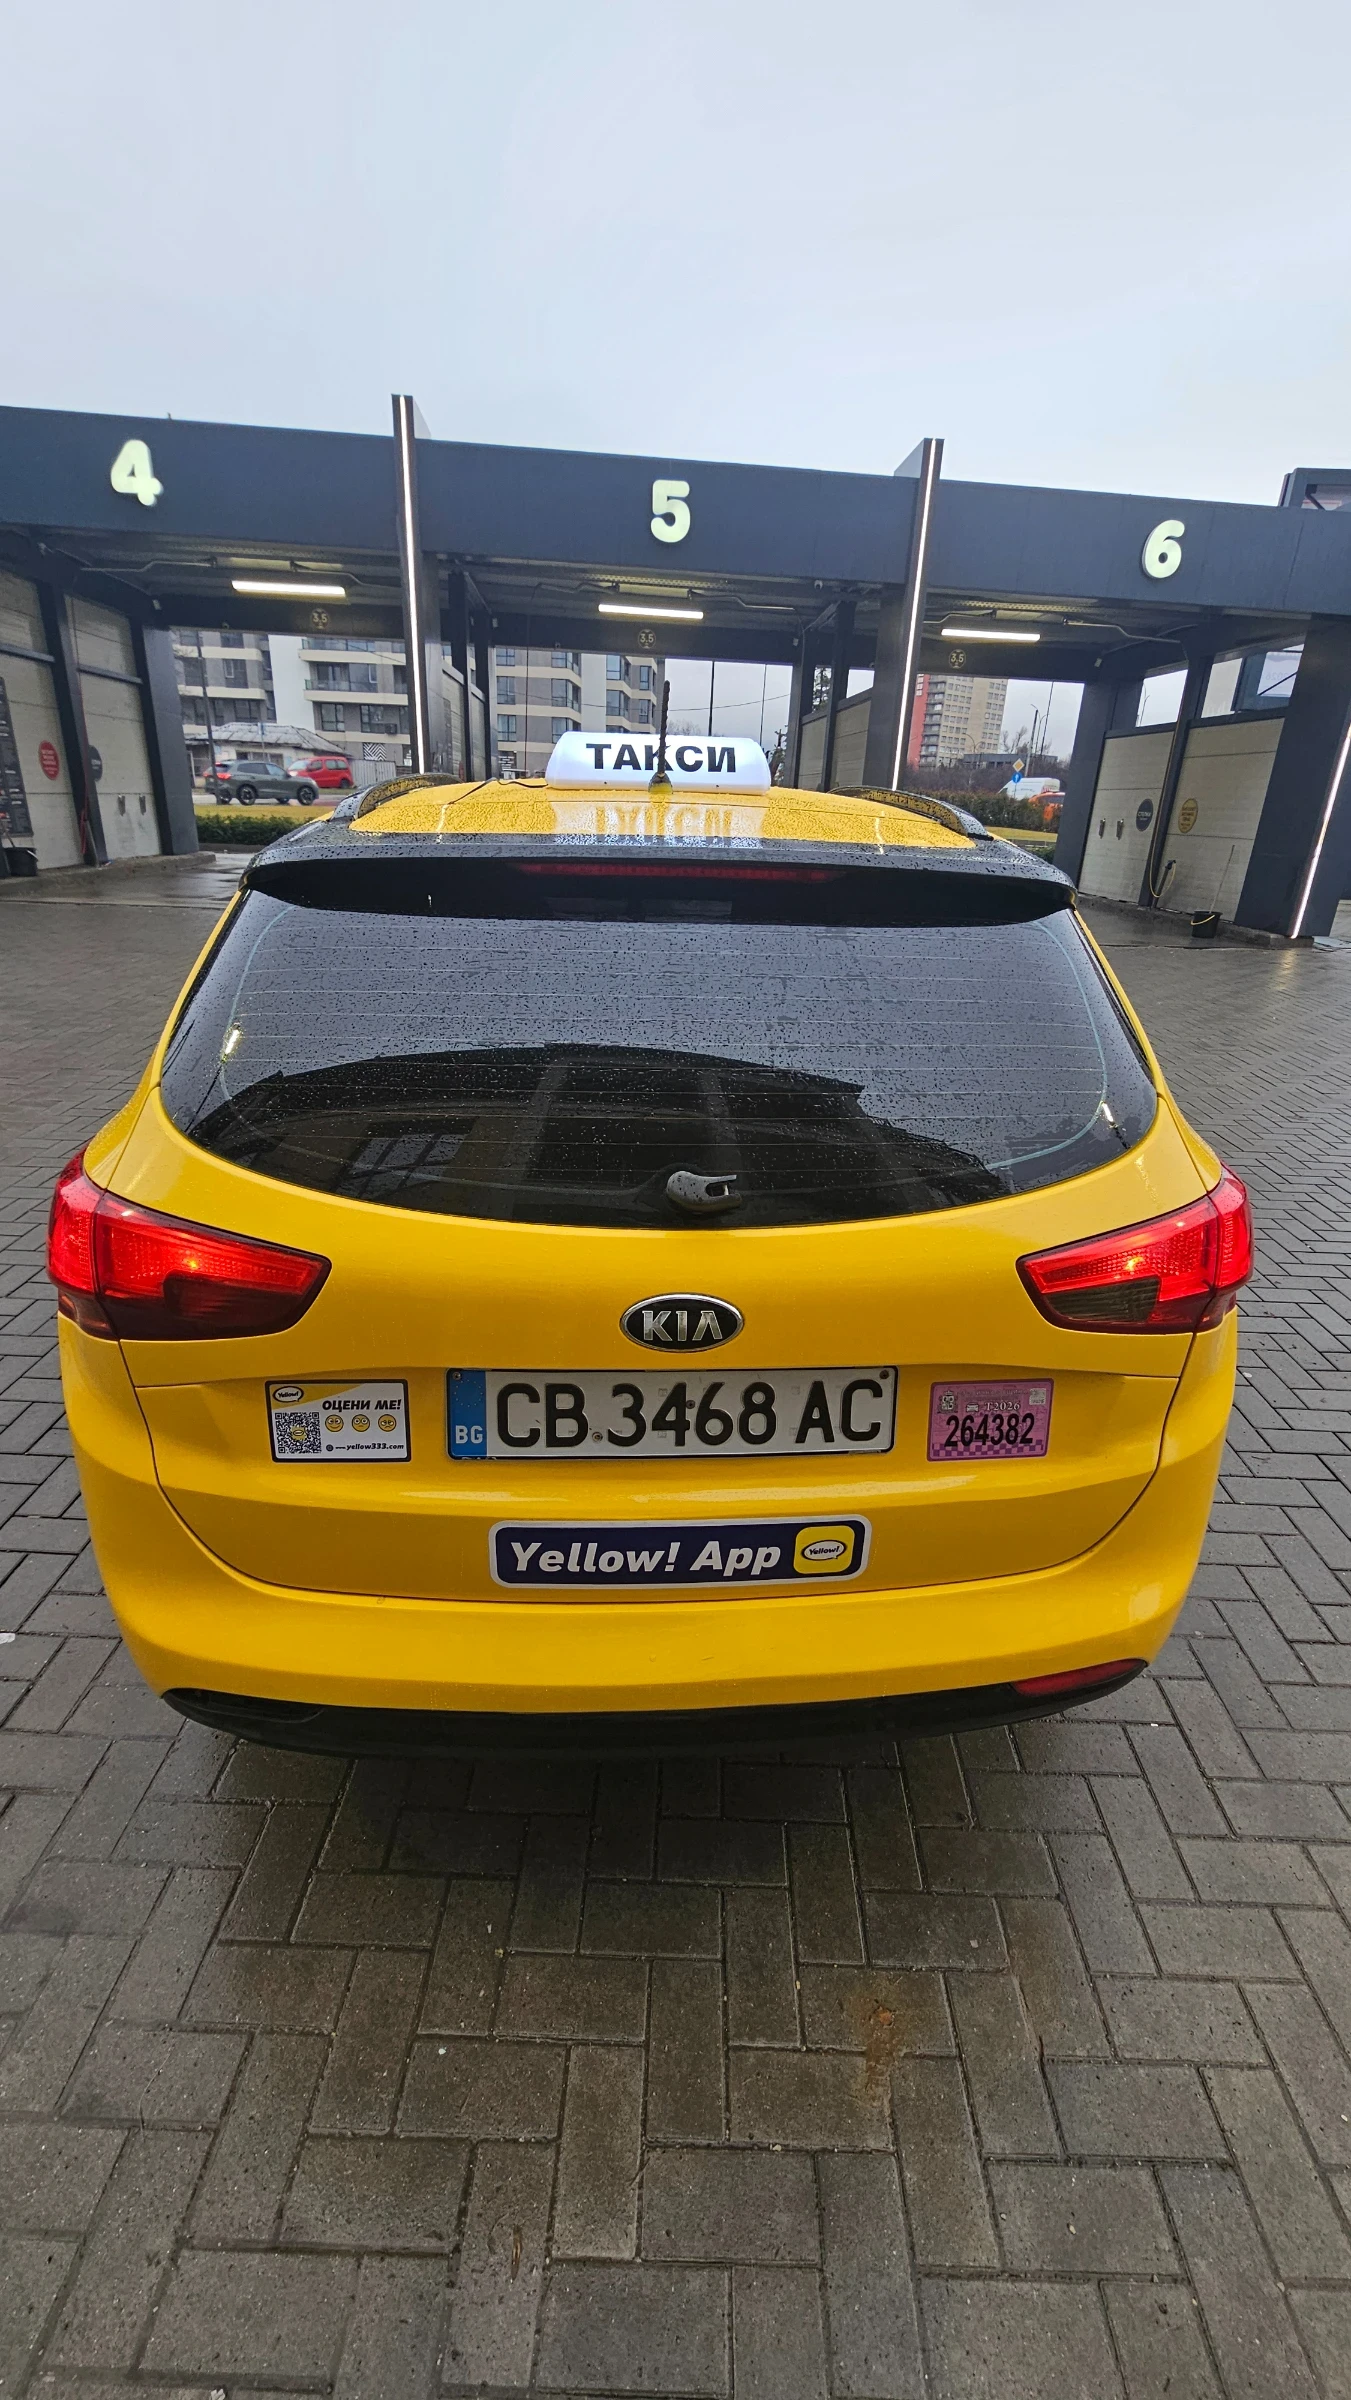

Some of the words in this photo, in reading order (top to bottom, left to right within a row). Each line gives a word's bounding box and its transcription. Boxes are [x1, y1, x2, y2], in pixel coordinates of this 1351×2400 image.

[111, 440, 163, 506] 4
[651, 480, 690, 542] 5
[1142, 520, 1185, 578] 6
[586, 743, 737, 773] ТАКСИ
[642, 1310, 723, 1341] KIA
[322, 1399, 371, 1413] ОЦЕНИ
[374, 1399, 402, 1410] МЕ!
[455, 1425, 483, 1444] BG
[944, 1412, 1035, 1448] 264382
[510, 1541, 681, 1573] Yellow!
[689, 1540, 781, 1576] App
[809, 1546, 840, 1555] Yellow!
